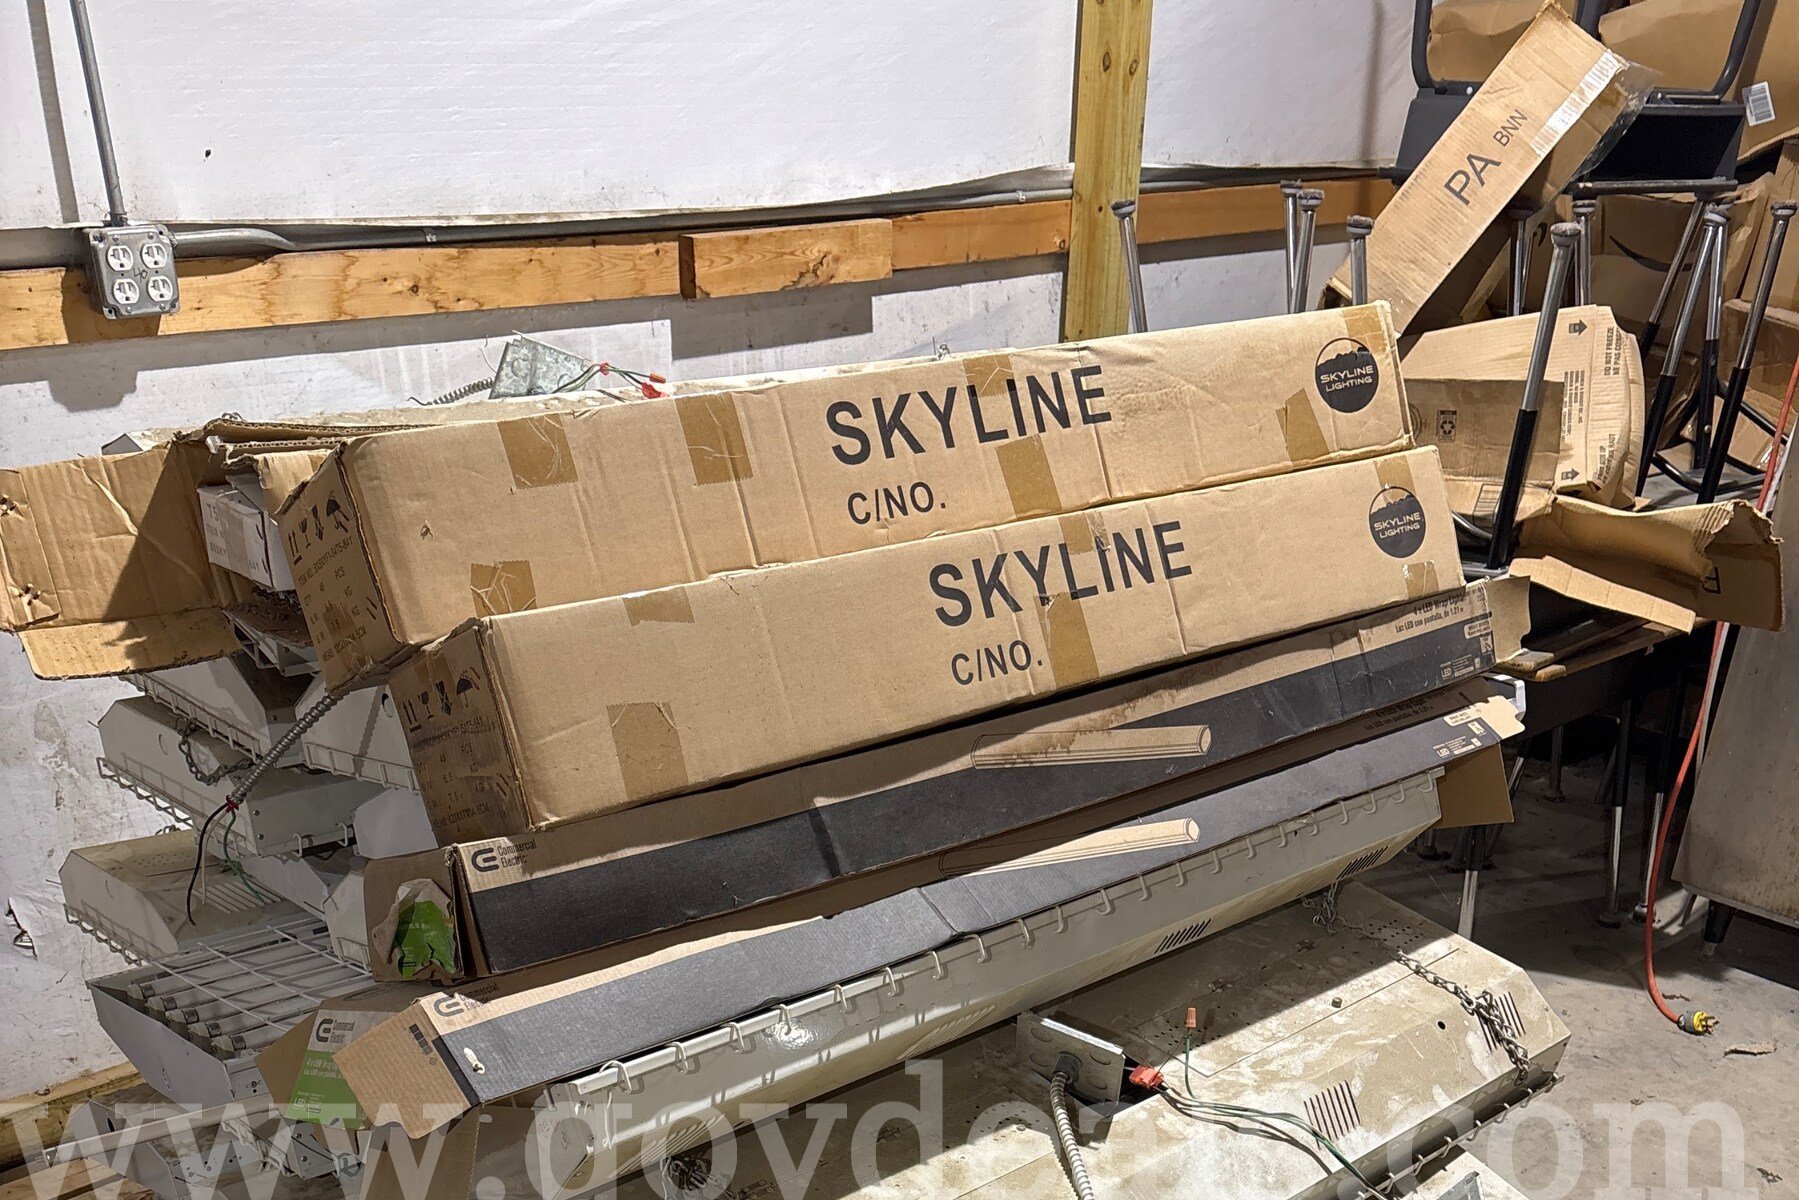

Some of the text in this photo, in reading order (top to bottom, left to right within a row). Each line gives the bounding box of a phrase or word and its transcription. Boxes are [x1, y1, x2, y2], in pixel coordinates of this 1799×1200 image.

[1444, 108, 1528, 206] PA BNN
[1606, 326, 1614, 350] FREEZE
[1320, 365, 1374, 383] SKYLINE
[1325, 376, 1373, 392] LIGHTING
[826, 365, 1112, 466] SKYLINE
[847, 481, 947, 525] C/NO.
[1374, 512, 1421, 531] SKYLINE
[1379, 522, 1420, 539] LIGHTING
[929, 520, 1193, 627] SKYLINE
[1423, 602, 1433, 612] LED
[1405, 621, 1414, 631] LED
[951, 639, 1043, 686] C/NO.
[497, 838, 537, 856] Commercial
[500, 853, 528, 868] Electric
